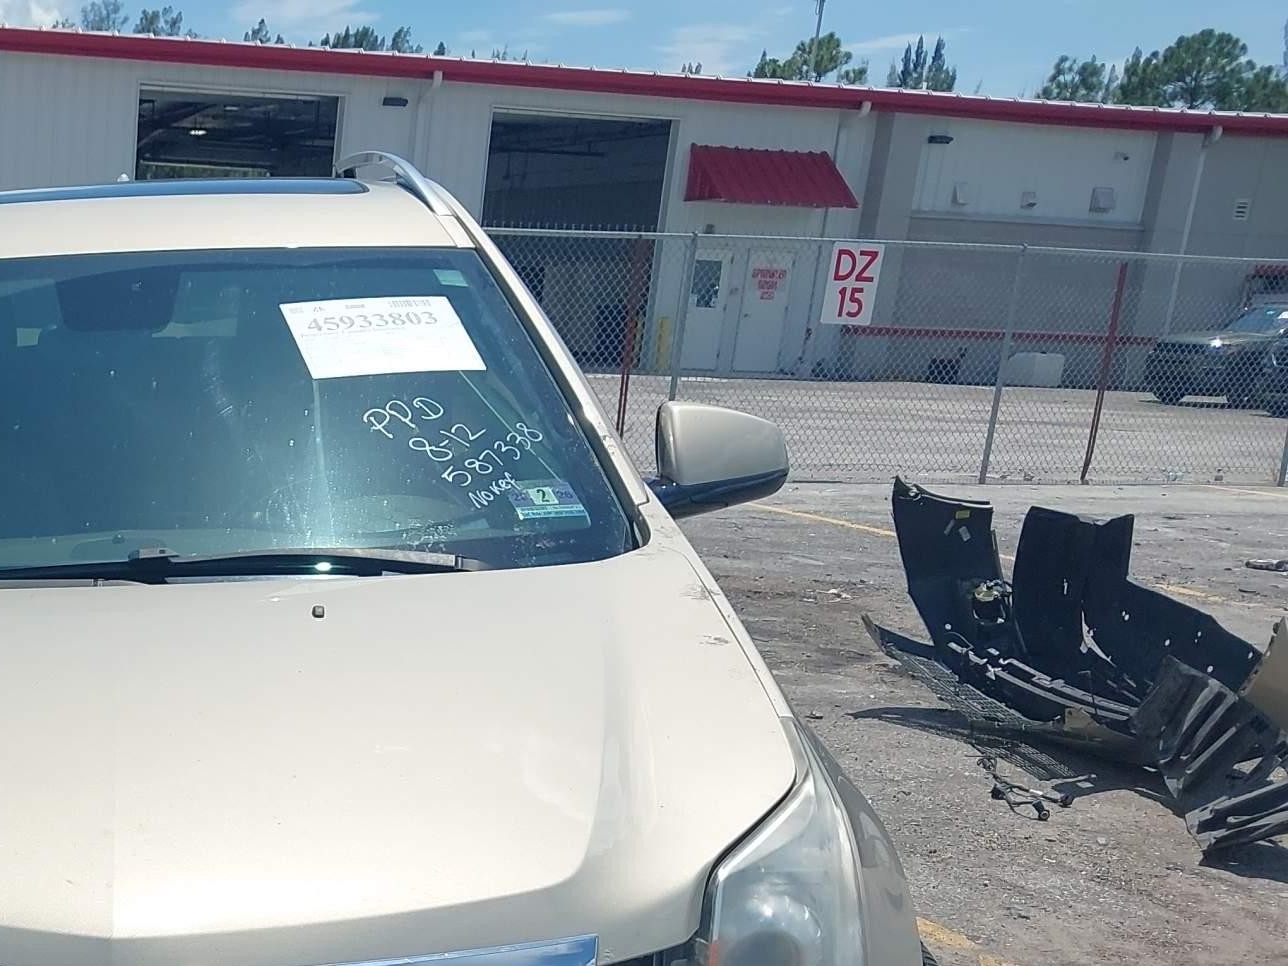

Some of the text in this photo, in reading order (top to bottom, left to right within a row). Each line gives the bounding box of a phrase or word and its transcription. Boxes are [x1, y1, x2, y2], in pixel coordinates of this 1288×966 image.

[833, 249, 879, 282] DZ
[837, 287, 864, 318] 15
[307, 311, 438, 332] 45933803
[363, 397, 444, 438] PPD
[408, 423, 487, 461] 8-12
[441, 422, 543, 487] 587338
[536, 488, 551, 503] 2
